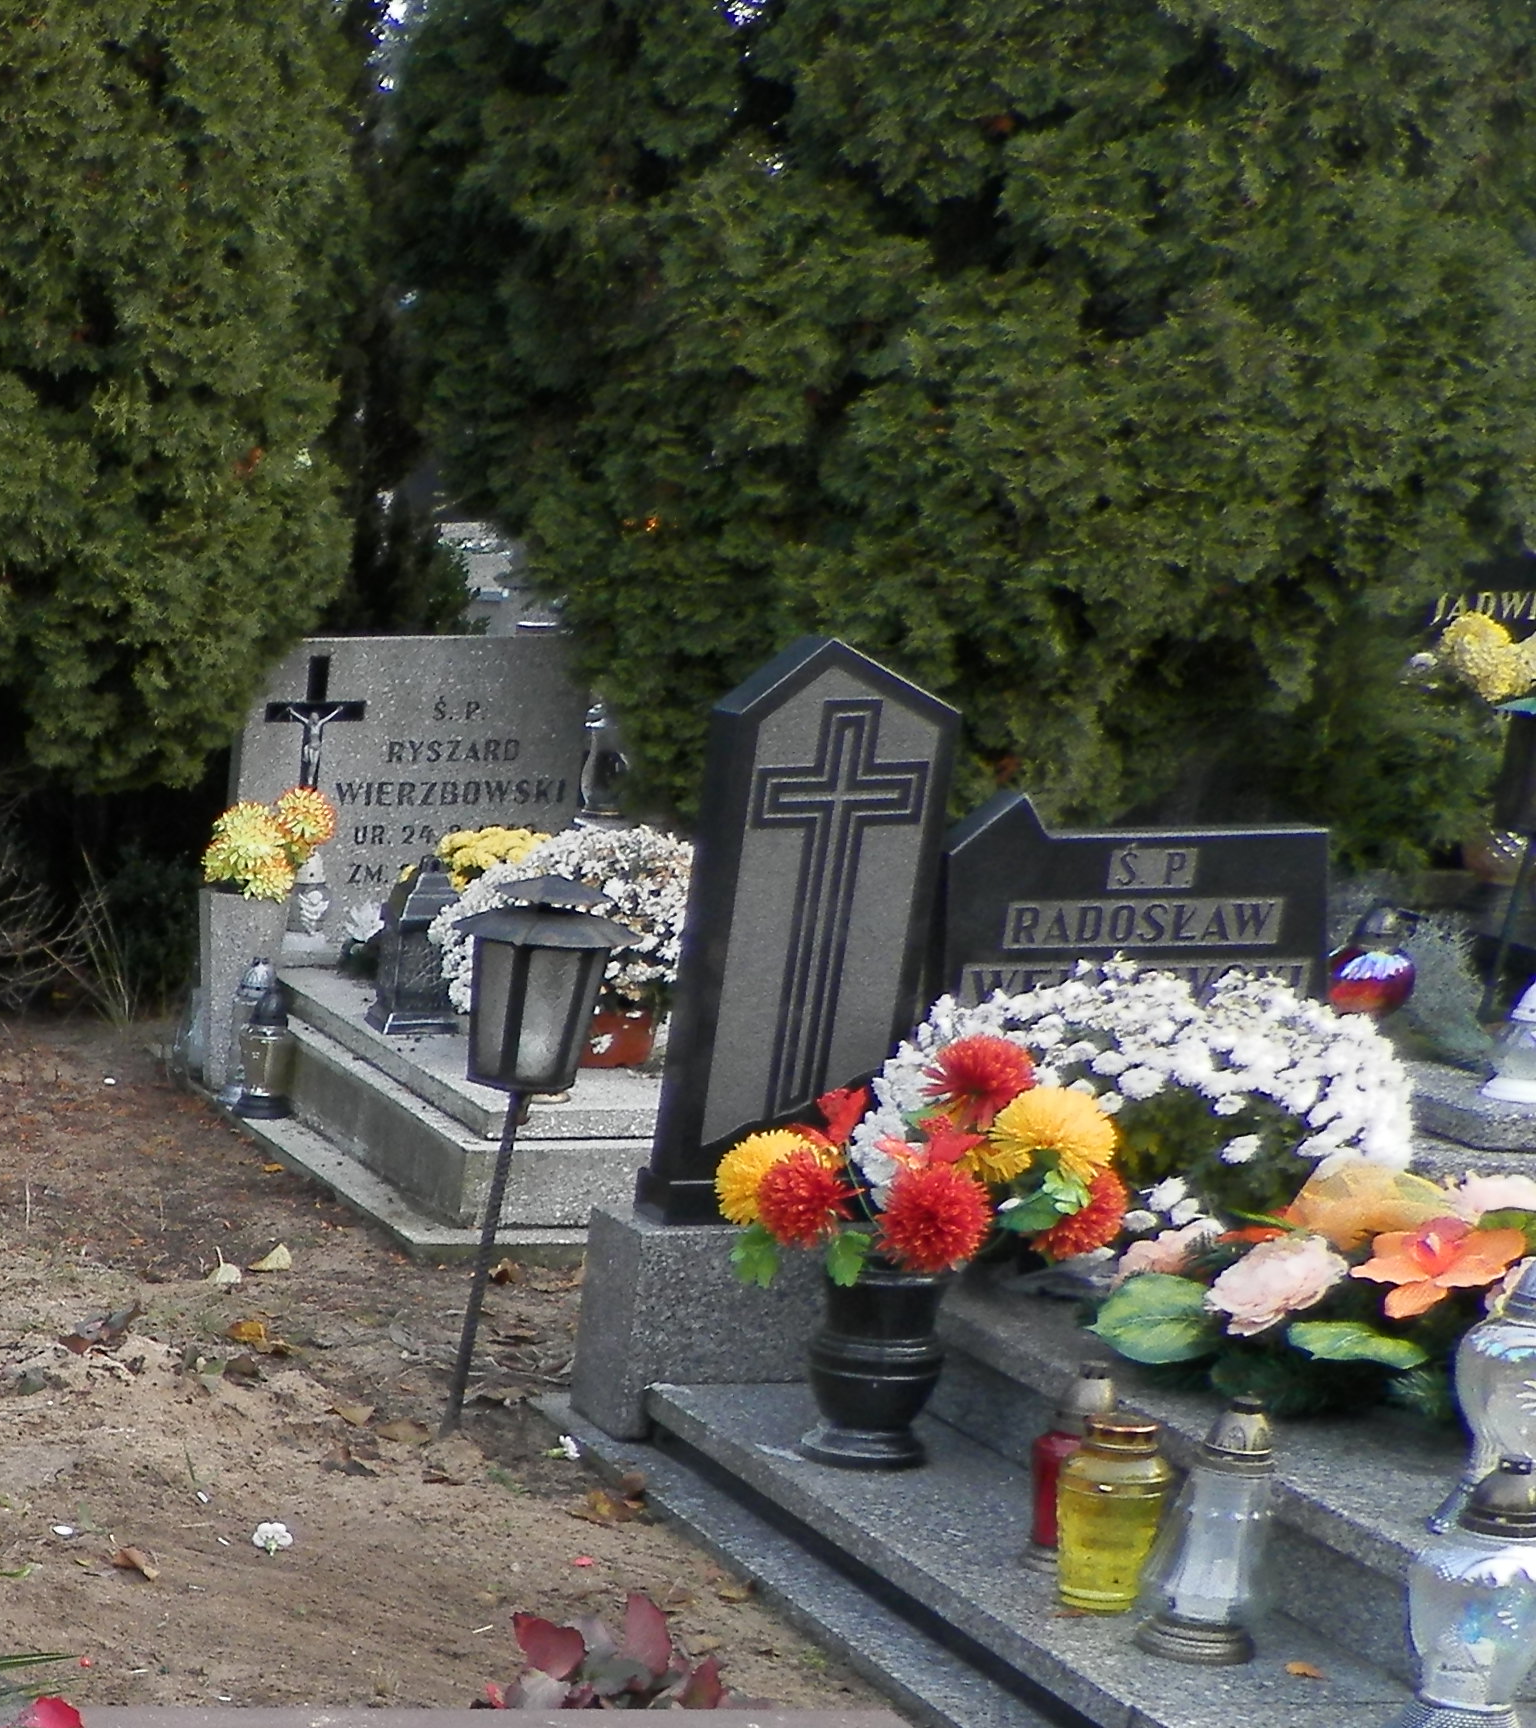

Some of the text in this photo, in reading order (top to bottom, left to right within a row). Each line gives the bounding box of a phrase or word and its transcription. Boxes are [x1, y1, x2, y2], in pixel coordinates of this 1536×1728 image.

[385, 738, 521, 764] RYSZARD
[334, 779, 567, 807] WIERZBOWSKI
[1010, 902, 1277, 944] RADOSŁAW
